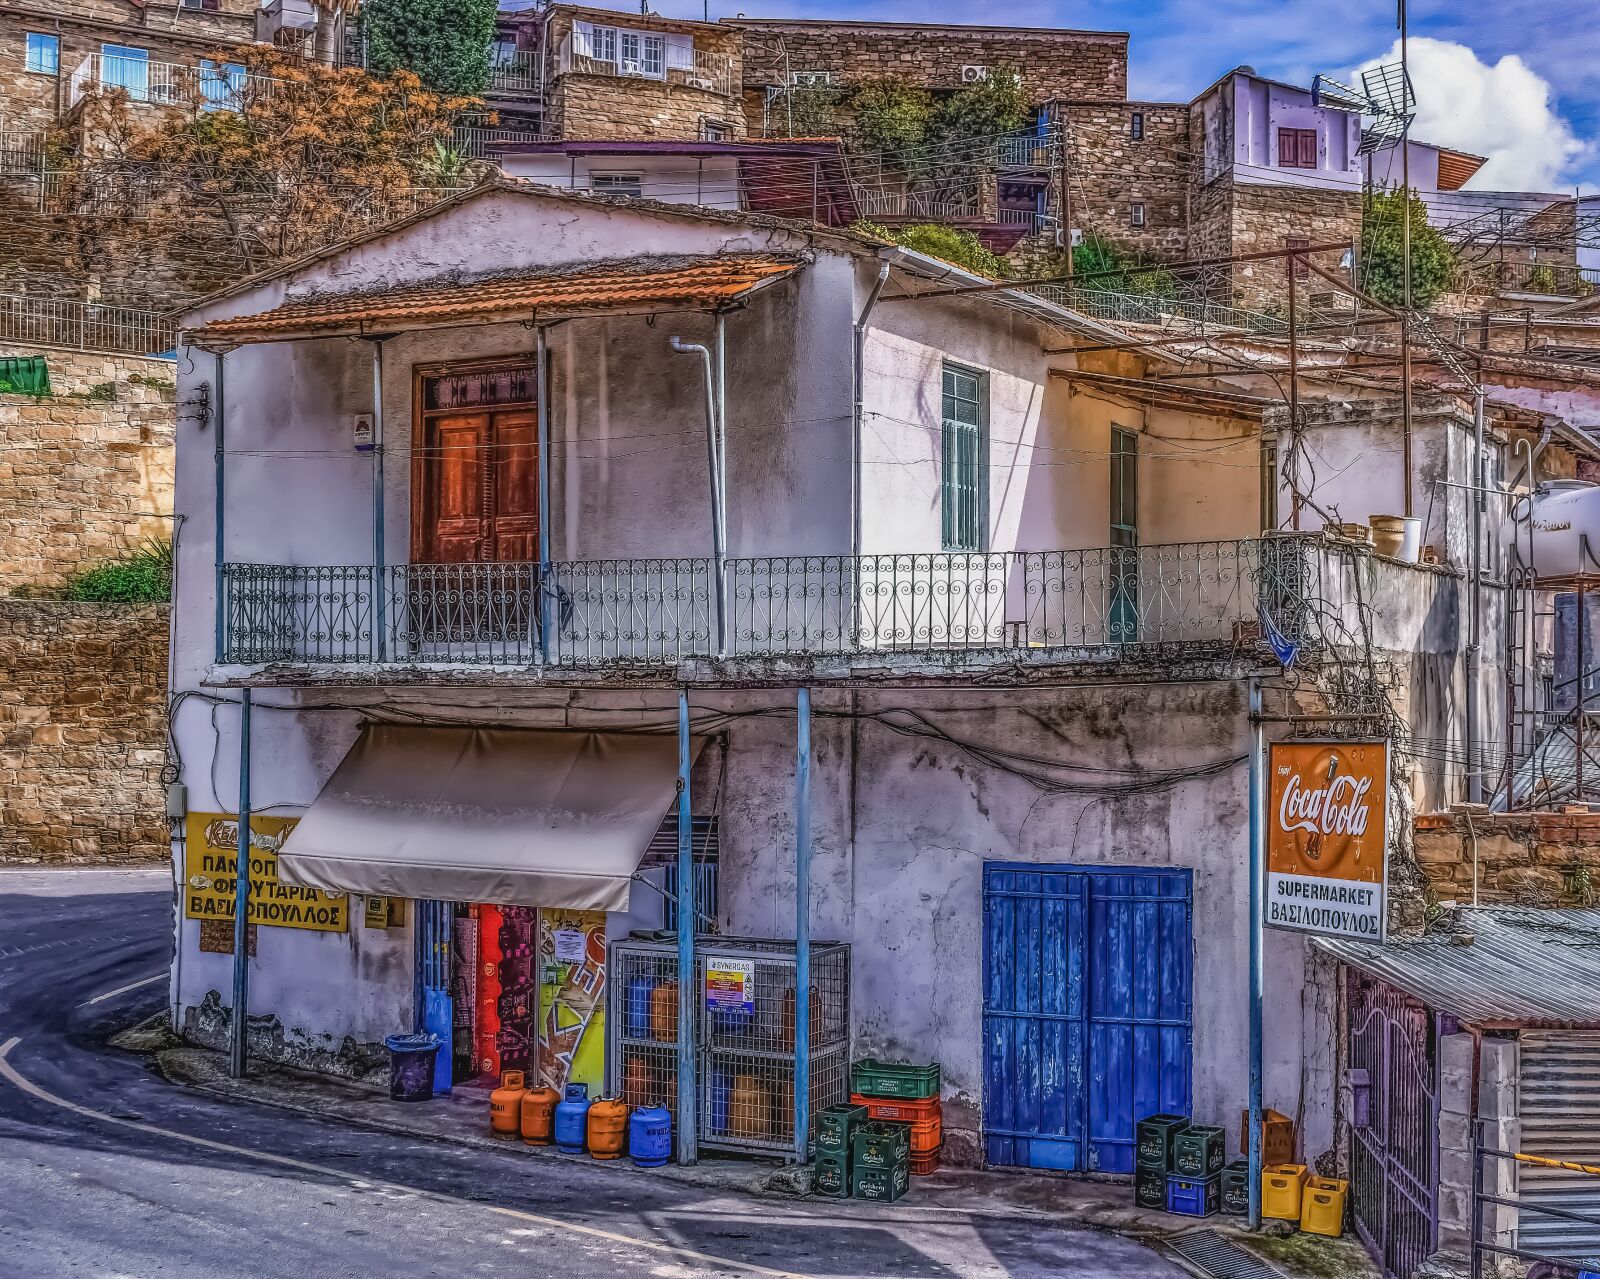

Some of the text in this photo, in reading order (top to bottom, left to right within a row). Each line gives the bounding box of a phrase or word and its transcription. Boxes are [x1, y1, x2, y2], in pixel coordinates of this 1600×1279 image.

[1279, 775, 1372, 836] Coca-Cola
[1278, 880, 1373, 906] SUPERMARKET
[1272, 902, 1378, 934] ΒΑΣΙΛΟΠΟΥΛΟΣ
[717, 961, 750, 971] SYNERGAS
[862, 1153, 884, 1163] Carlsberg
[859, 1180, 885, 1192] Carlsberg
